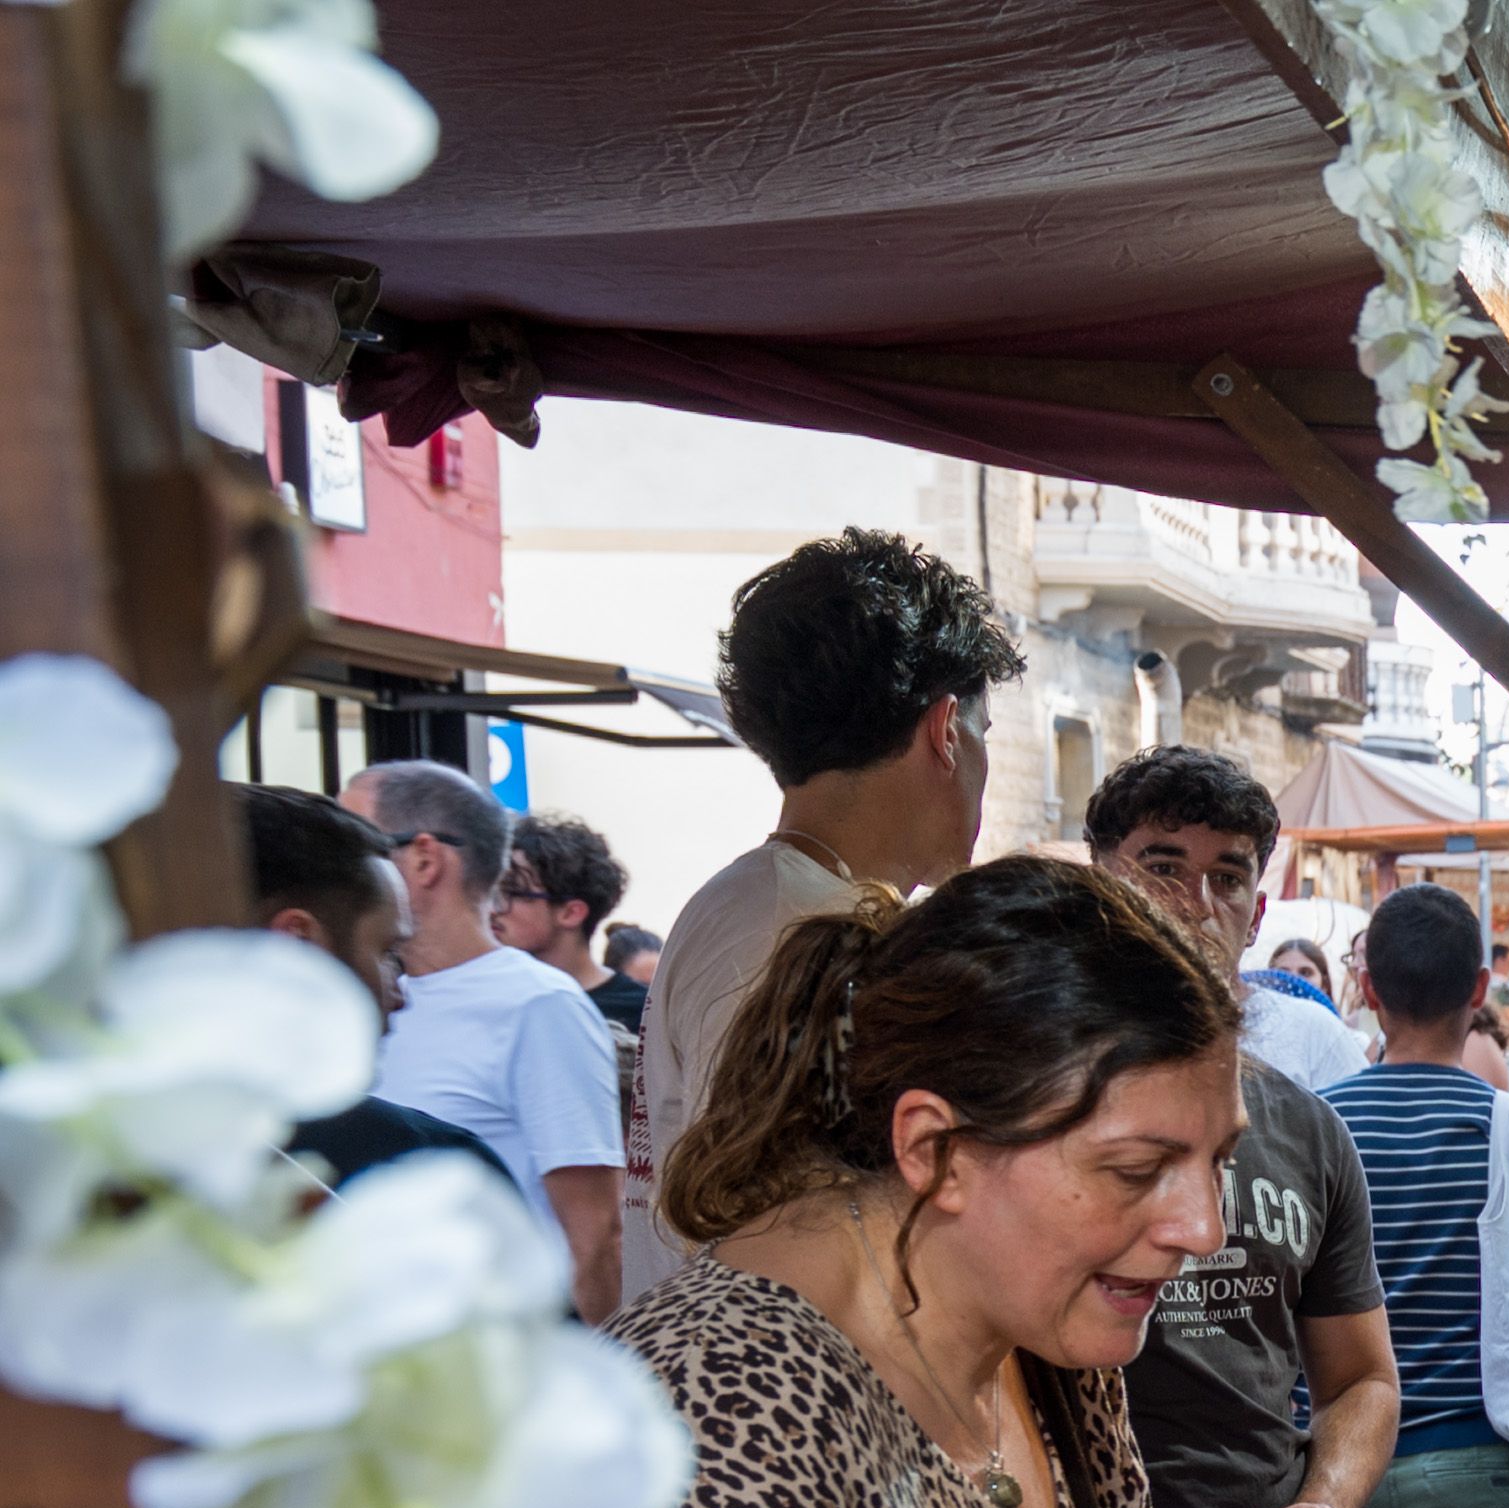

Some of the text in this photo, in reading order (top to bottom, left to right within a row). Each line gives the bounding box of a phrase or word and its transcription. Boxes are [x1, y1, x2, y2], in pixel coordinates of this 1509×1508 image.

[1157, 1277, 1277, 1307] CK&JONES
[1155, 1306, 1252, 1323] AUTHENTIC QUALIT
[1181, 1328, 1205, 1338] SINCE
